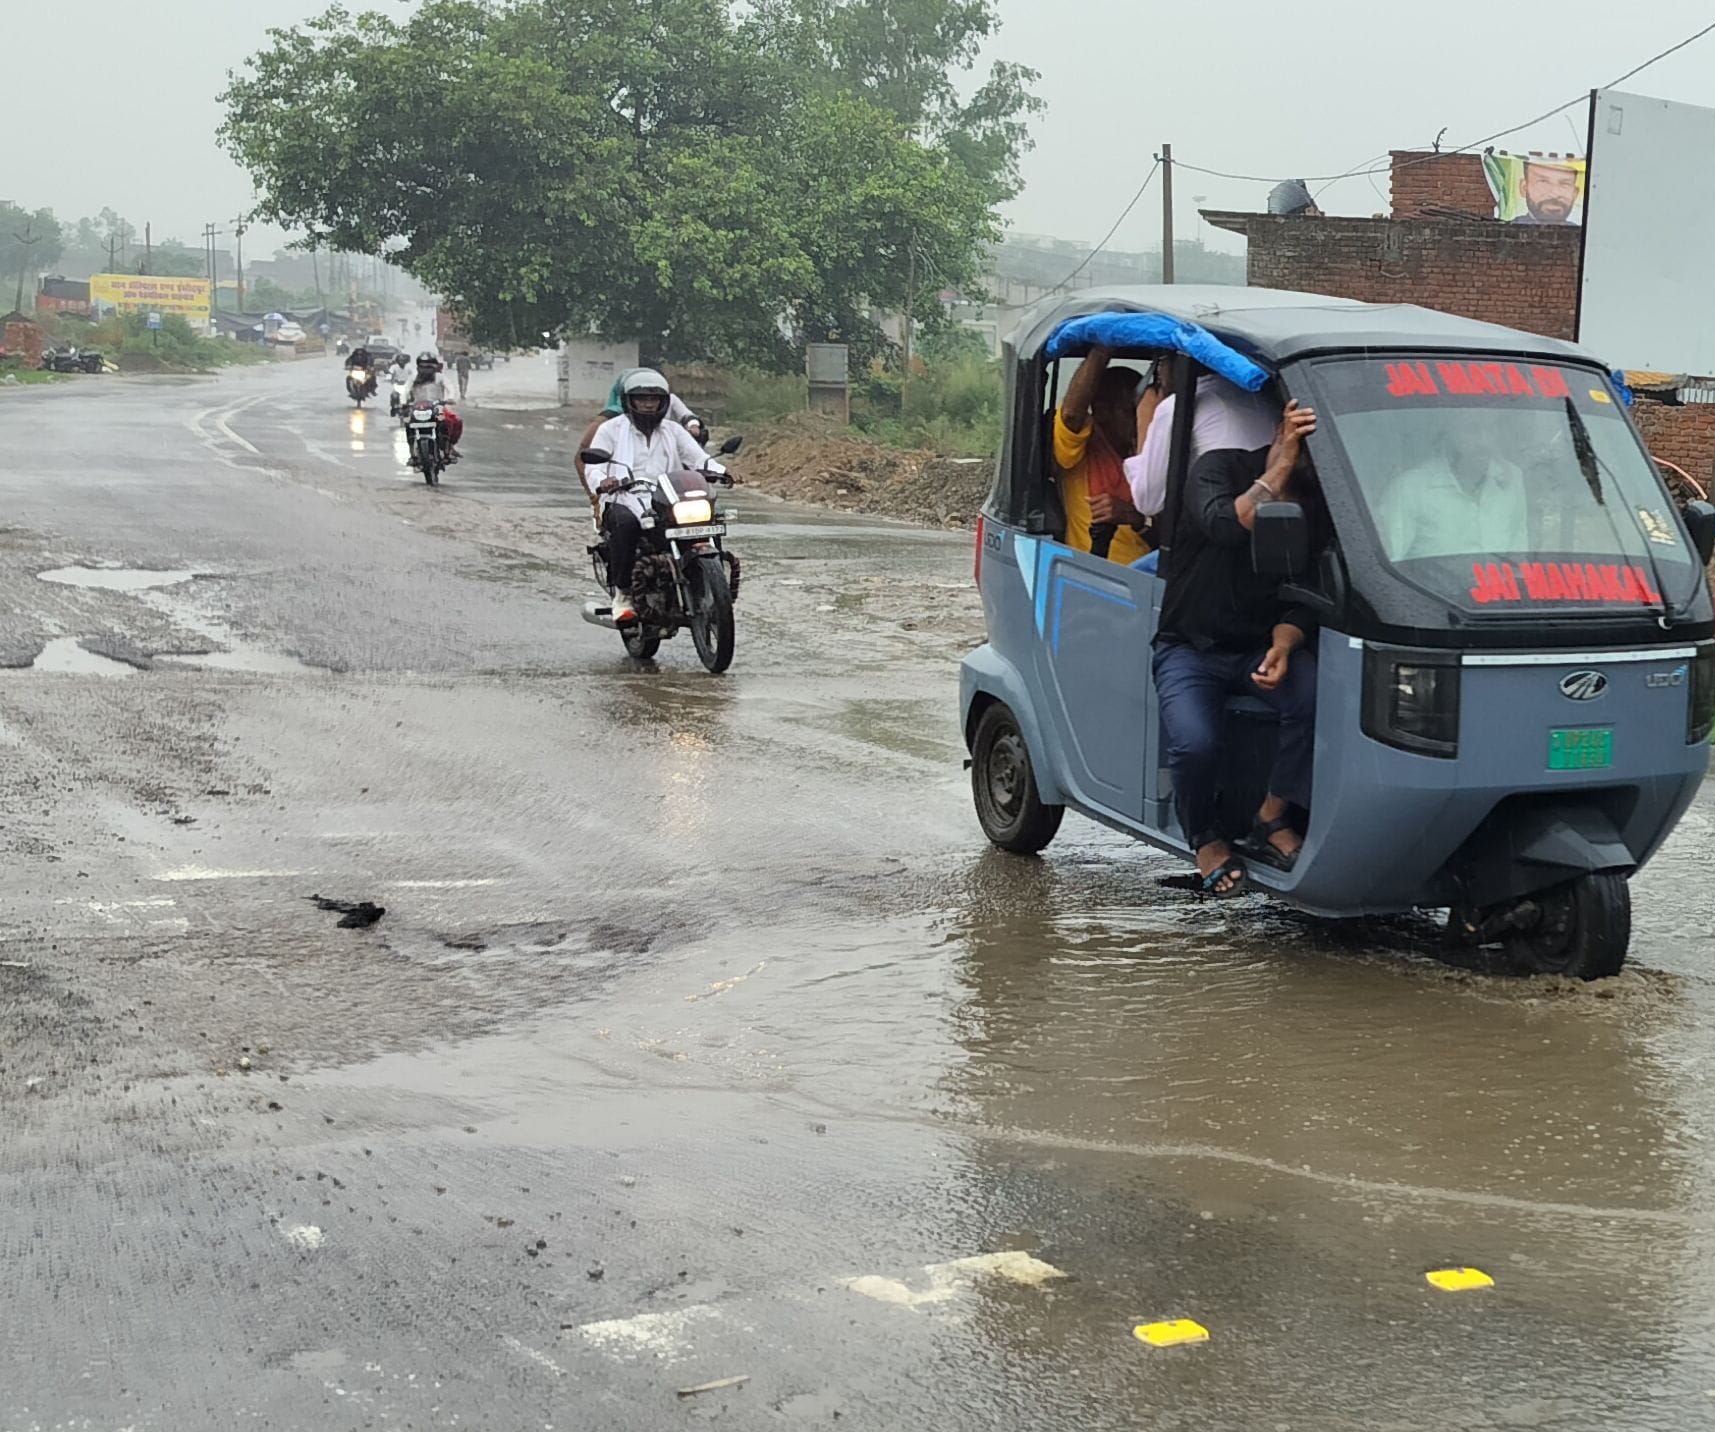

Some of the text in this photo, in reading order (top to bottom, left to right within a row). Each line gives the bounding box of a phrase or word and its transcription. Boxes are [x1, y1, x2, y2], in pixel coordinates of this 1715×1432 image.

[1385, 362, 1570, 398] JAI MATA DI
[1470, 562, 1662, 604] JAI MAHAKAL
